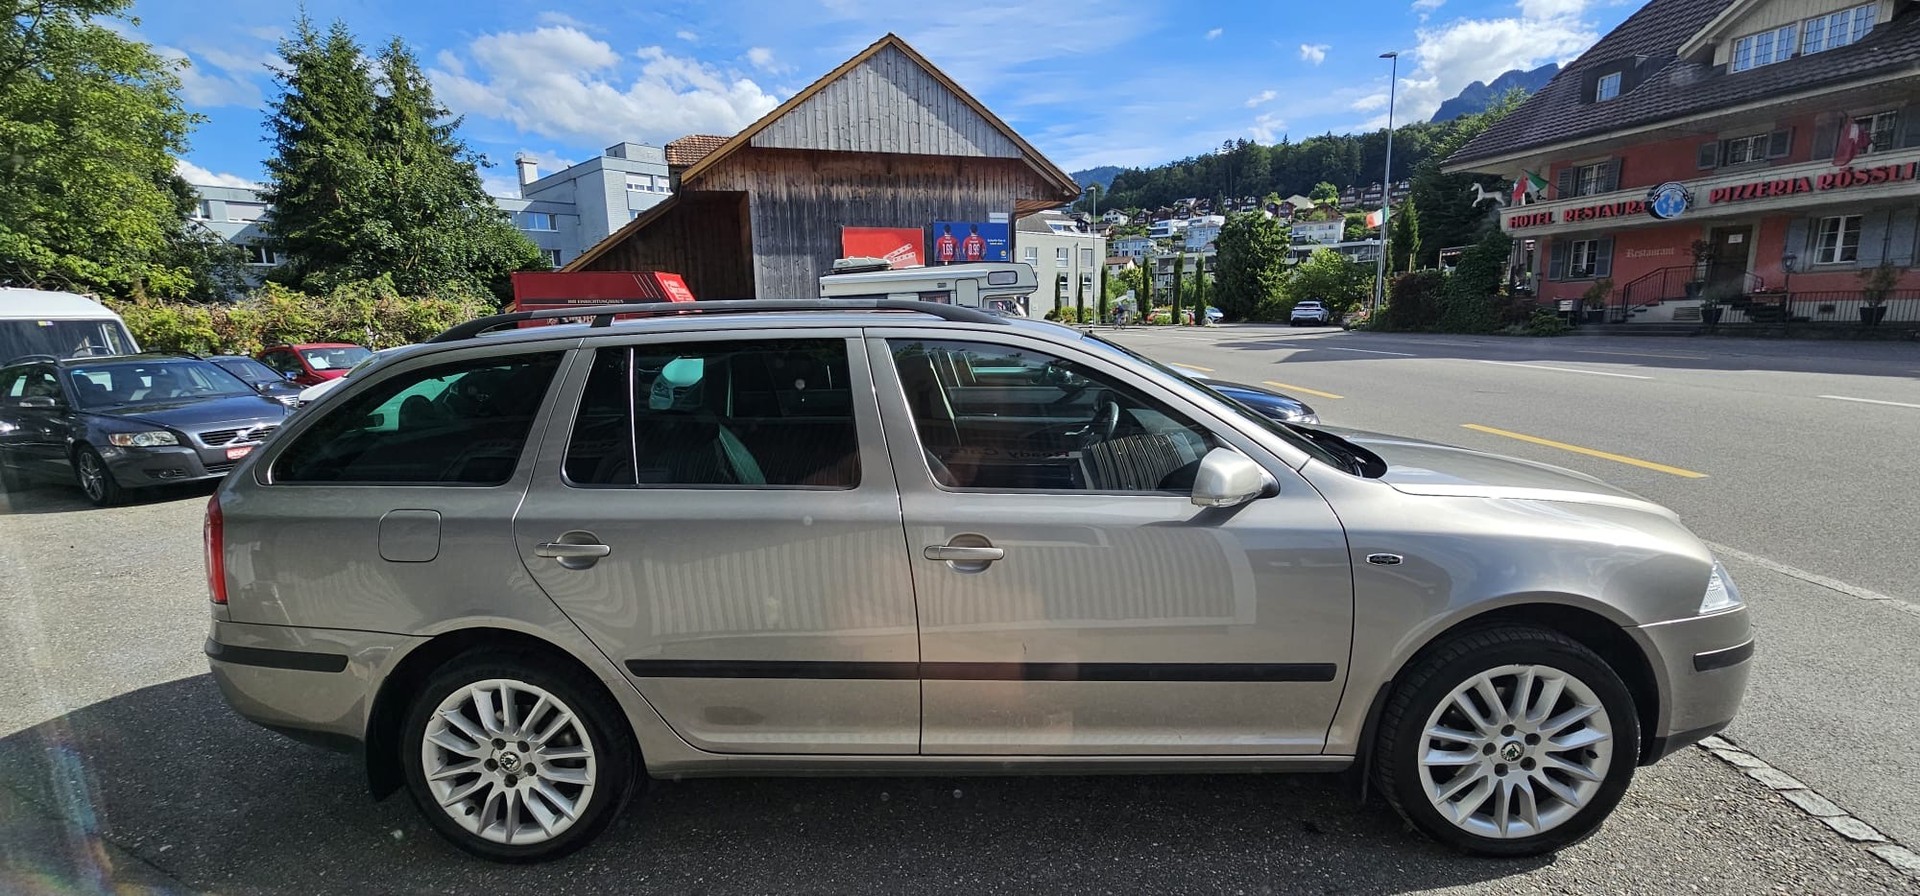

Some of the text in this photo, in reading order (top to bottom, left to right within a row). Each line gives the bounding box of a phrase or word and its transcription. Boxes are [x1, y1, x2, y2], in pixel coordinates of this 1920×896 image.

[1508, 212, 1554, 229] HOTEL
[1563, 200, 1647, 222] RESTAURA
[1708, 177, 1813, 204] PIZZERIA
[1816, 161, 1916, 190] RÖSSLI
[1625, 247, 1675, 258] Restaurant
